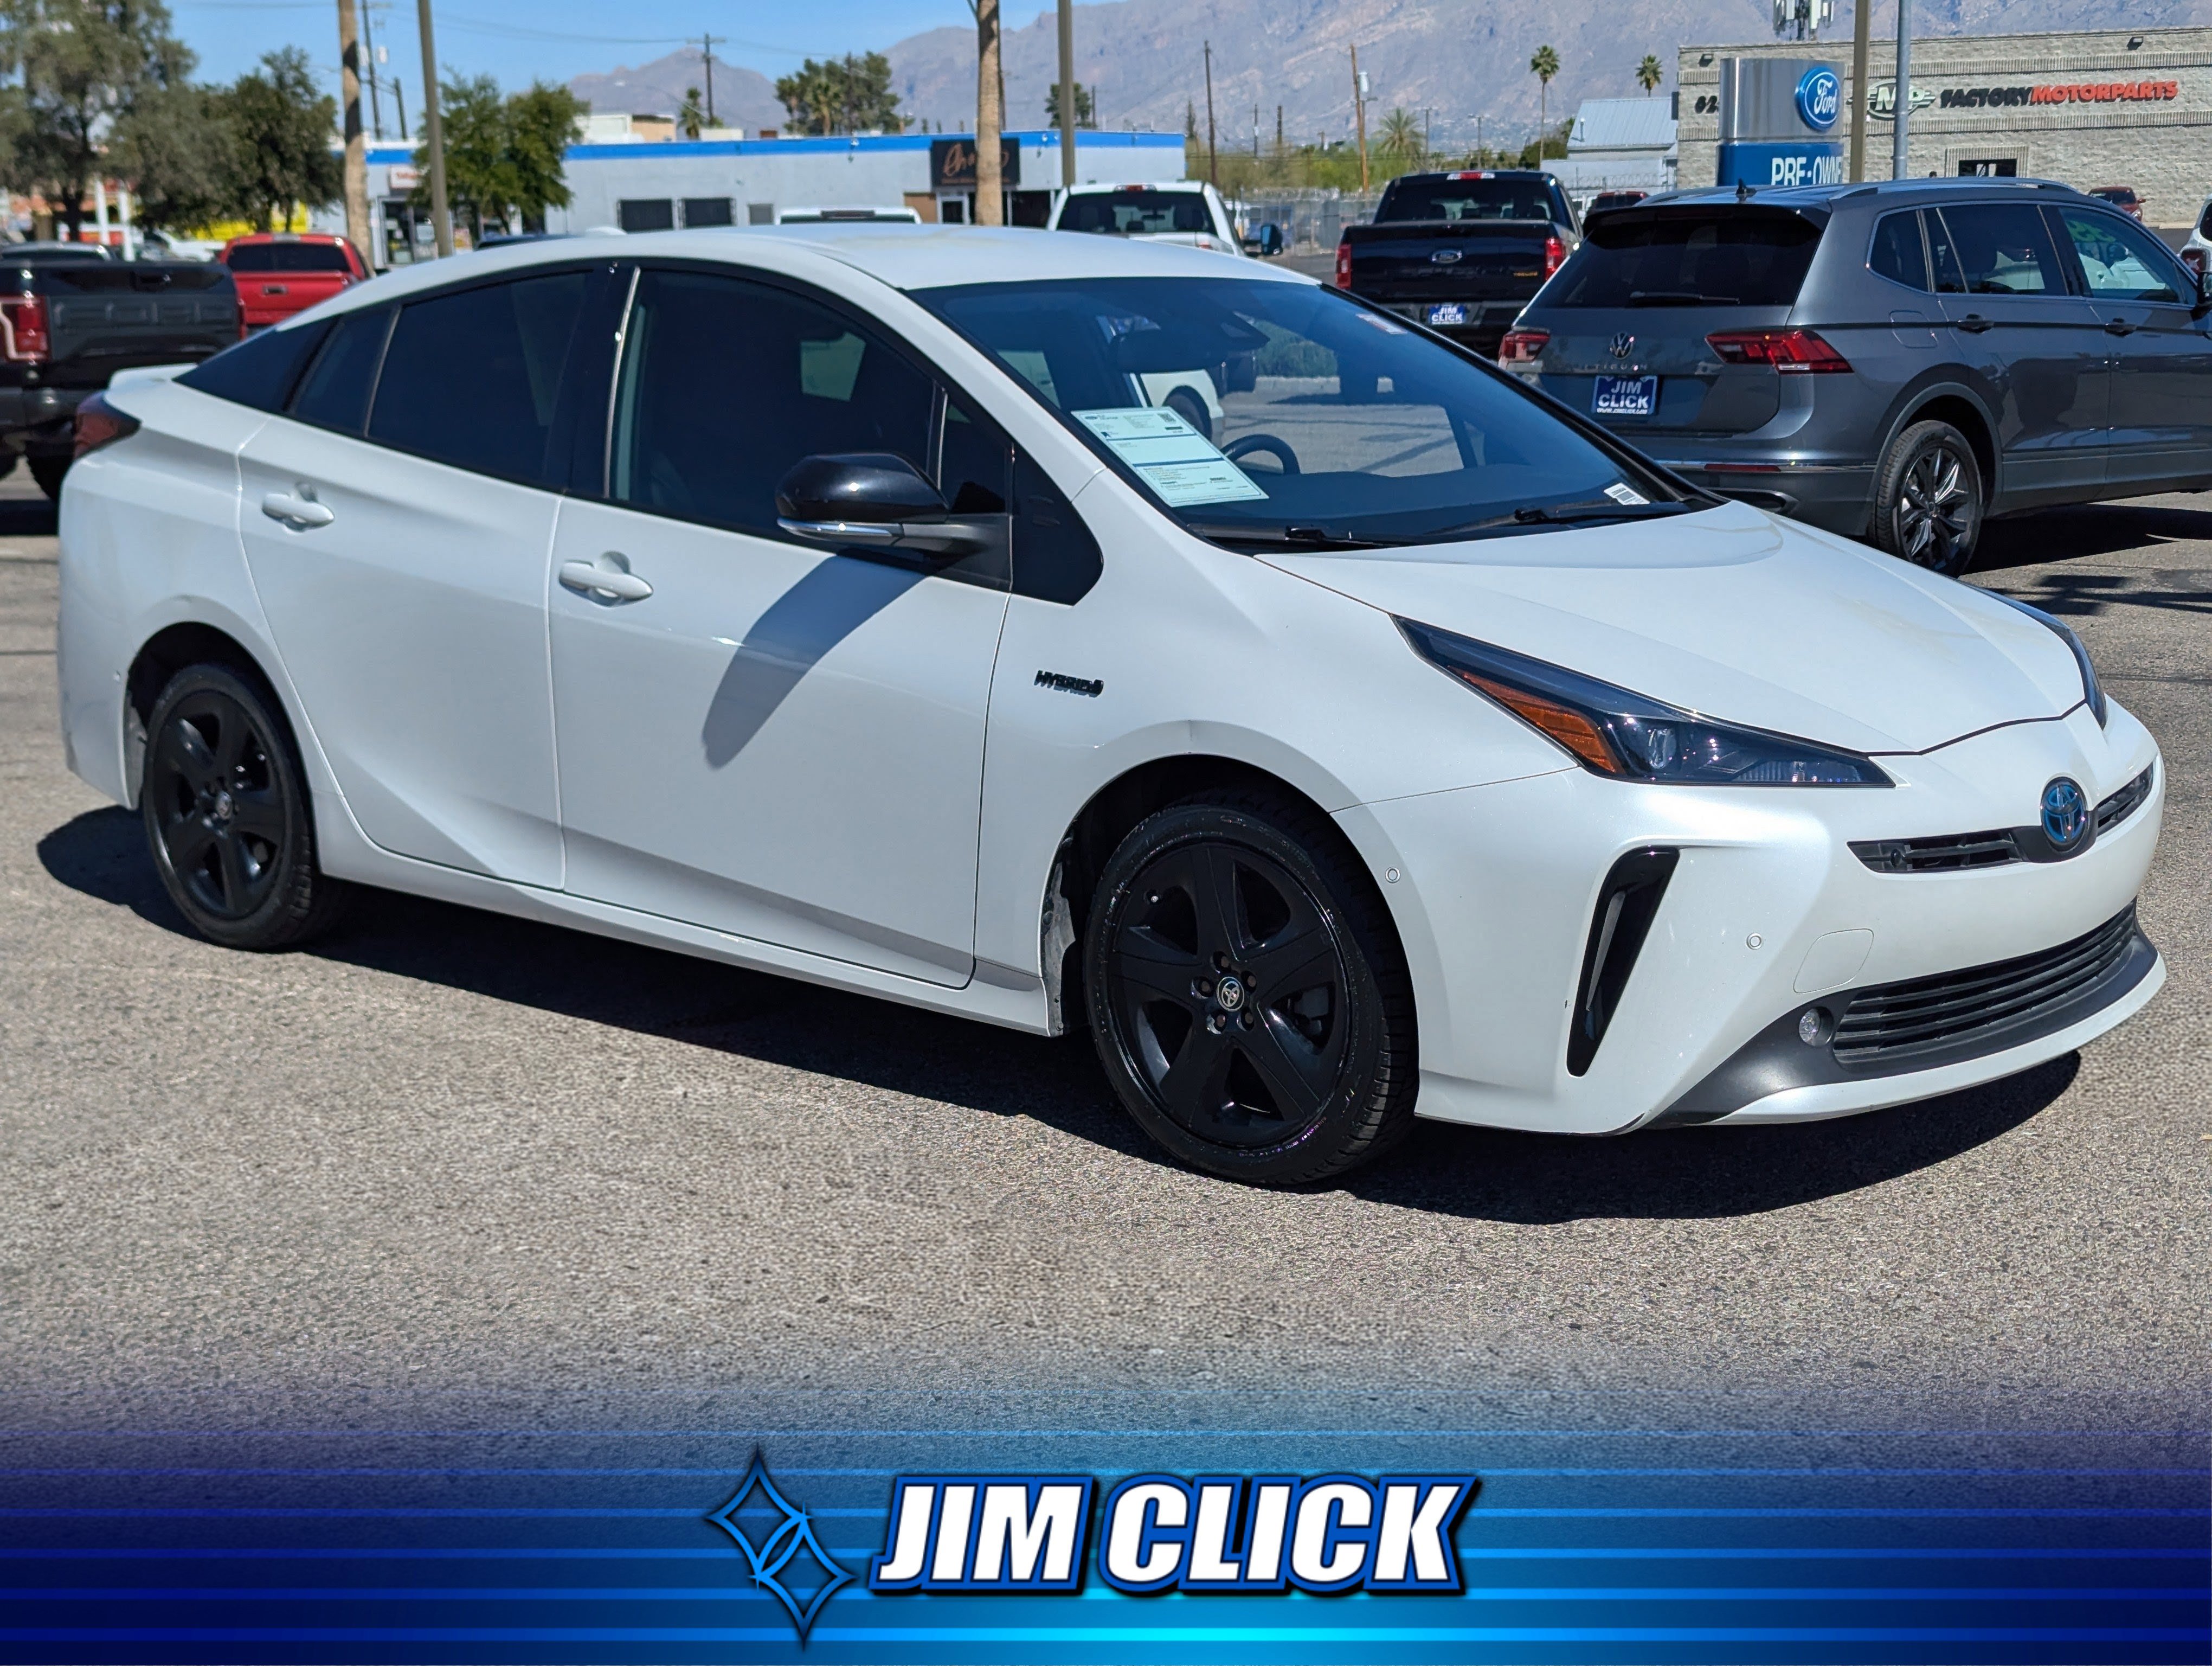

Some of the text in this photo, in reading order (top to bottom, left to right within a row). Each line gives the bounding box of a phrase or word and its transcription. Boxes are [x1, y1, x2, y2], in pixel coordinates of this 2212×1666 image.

[1814, 78, 1838, 114] Ford
[1432, 313, 1462, 322] CLICK
[1611, 381, 1642, 394] JIM
[1598, 394, 1649, 408] CLICK
